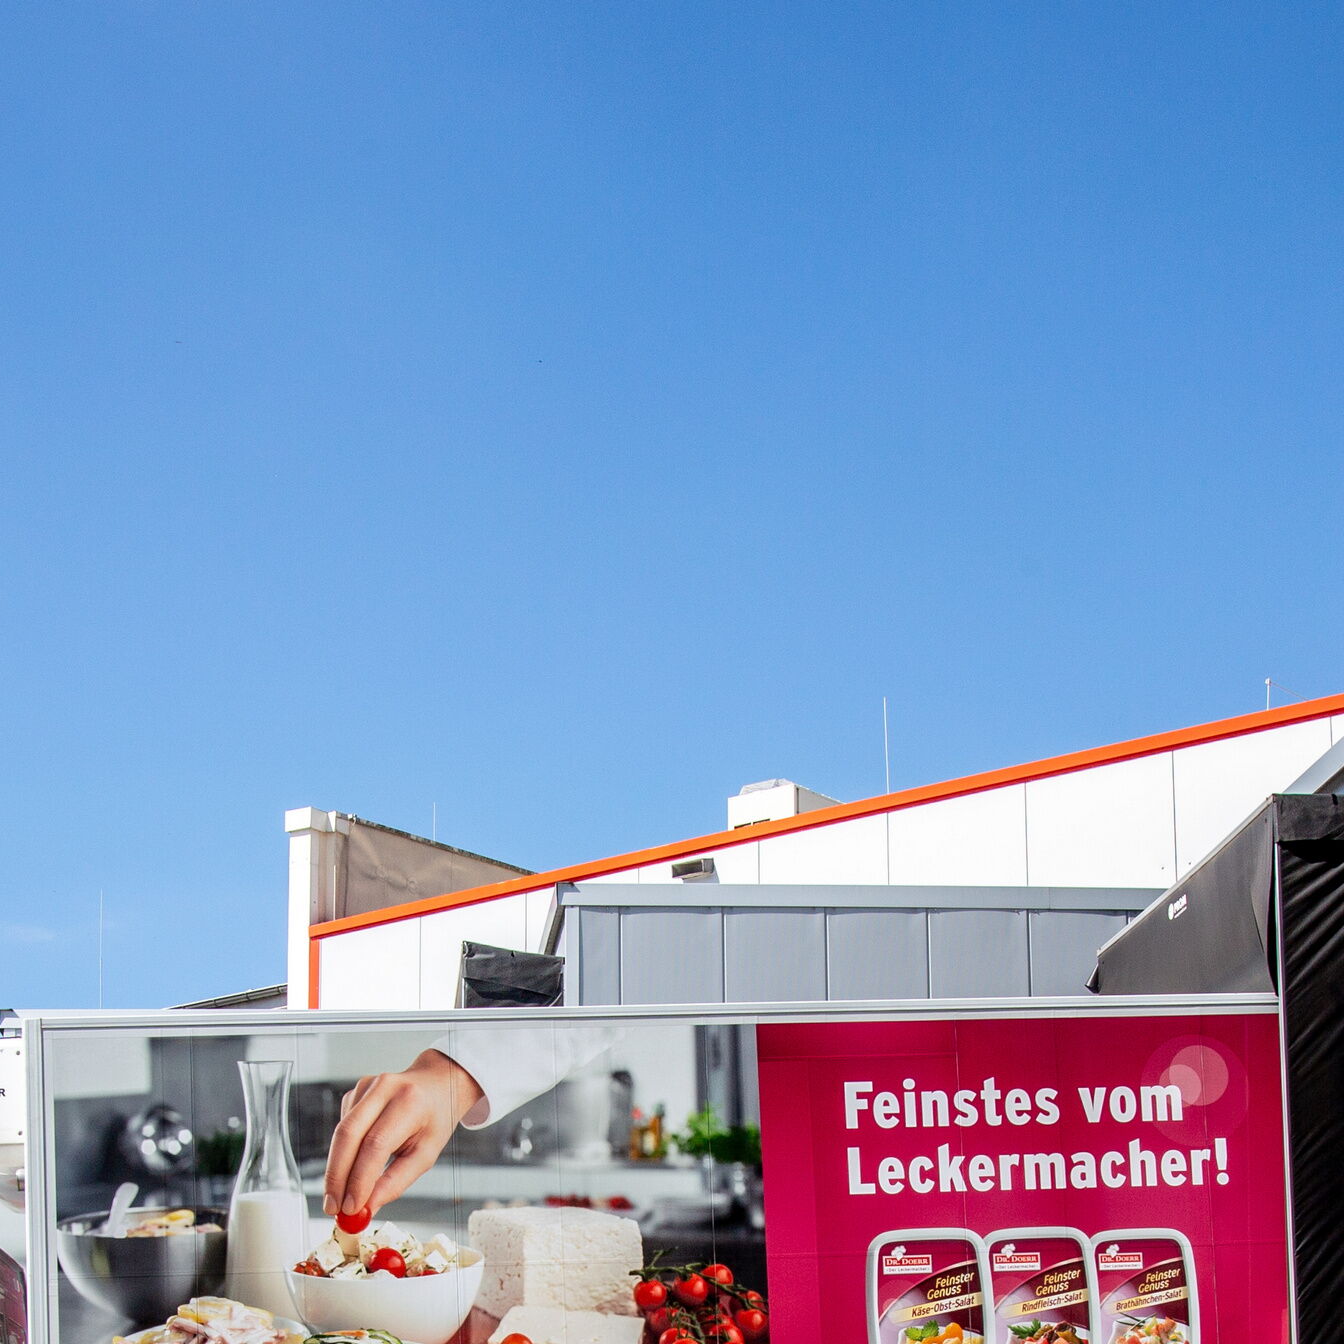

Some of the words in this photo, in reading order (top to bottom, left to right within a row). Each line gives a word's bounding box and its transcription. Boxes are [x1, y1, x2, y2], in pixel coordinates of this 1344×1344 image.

[844, 1077, 1060, 1130] Feinstes
[1078, 1083, 1184, 1124] vom
[847, 1138, 1231, 1196] Leckermacher!
[935, 1272, 974, 1289] Feinster
[1044, 1269, 1081, 1285] Feinster
[1145, 1268, 1181, 1283] Feinster
[927, 1285, 962, 1300] Genuss
[1035, 1281, 1069, 1296] Genuss
[1138, 1280, 1169, 1294] Genuss
[911, 1296, 975, 1318] Käse-Obst-Salat
[1021, 1292, 1082, 1312] Rindfleisch-Salat
[1116, 1289, 1182, 1311] Brathähnchen-Salat
